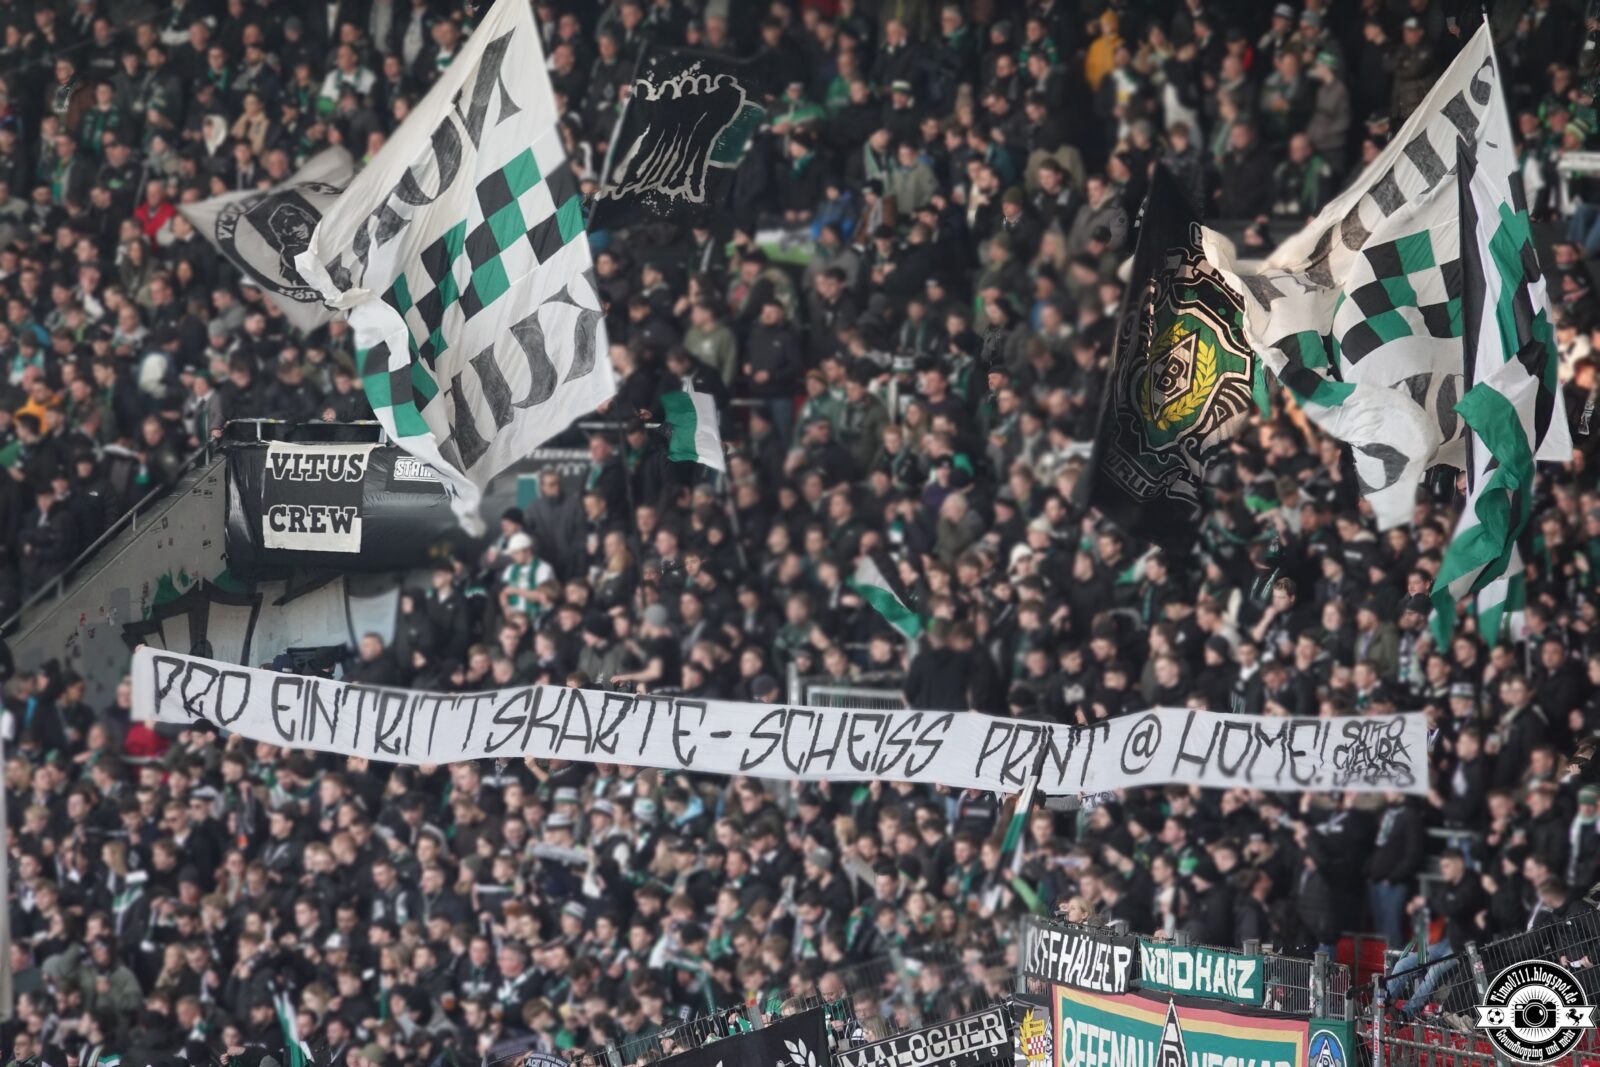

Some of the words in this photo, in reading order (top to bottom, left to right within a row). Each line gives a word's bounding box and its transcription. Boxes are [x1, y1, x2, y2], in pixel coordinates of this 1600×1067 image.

[270, 452, 365, 482] VITUS
[267, 503, 358, 535] CREW
[152, 656, 251, 727] PRO
[271, 676, 708, 767] EINTRITTSKARTE
[738, 708, 954, 776] SCHEISS
[1120, 713, 1162, 775] @
[1172, 708, 1331, 786] HOME!
